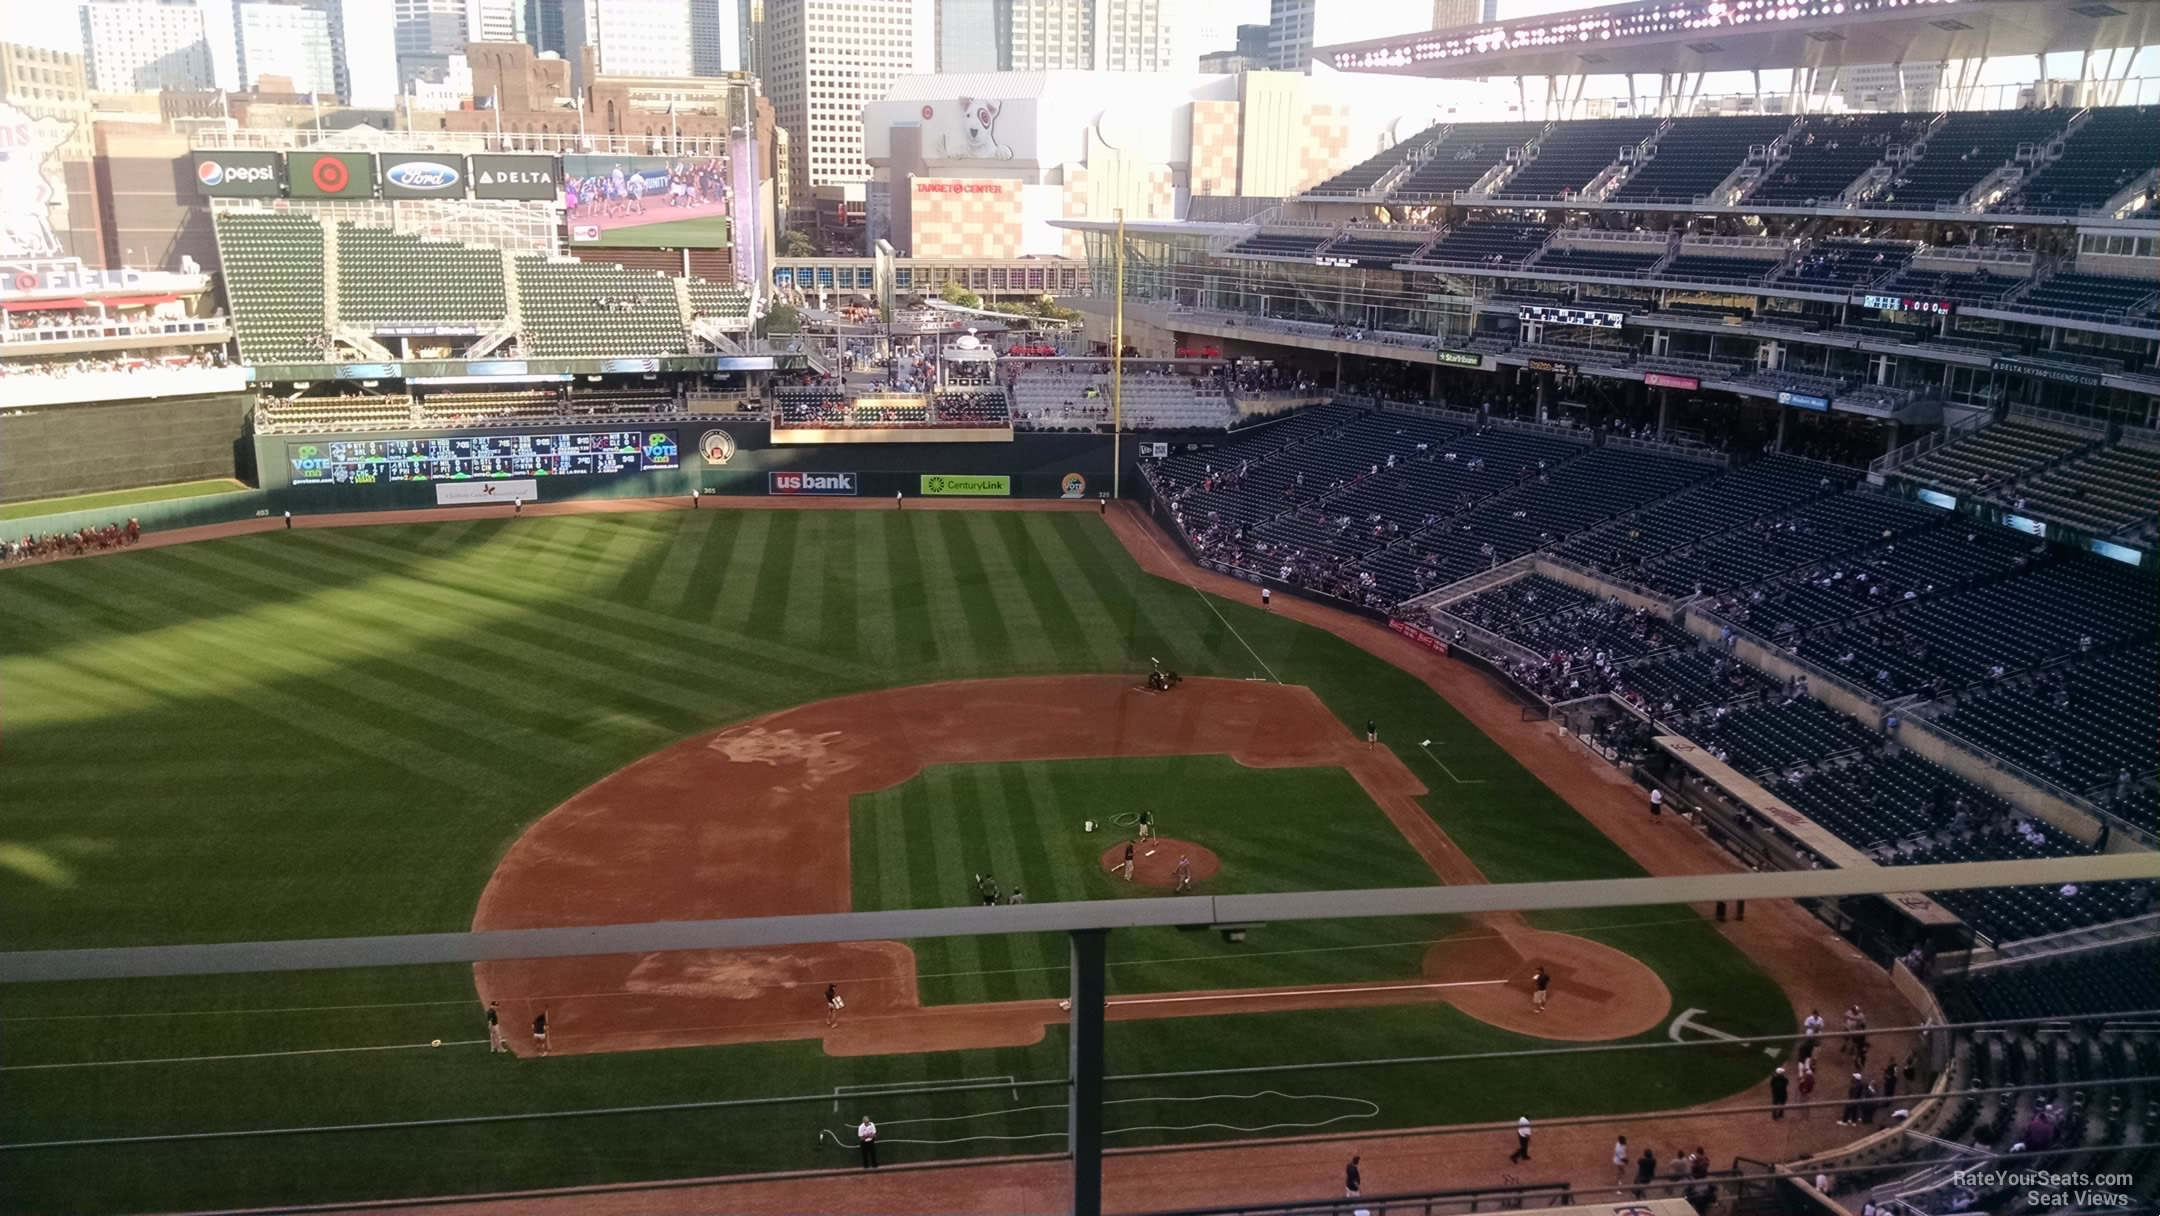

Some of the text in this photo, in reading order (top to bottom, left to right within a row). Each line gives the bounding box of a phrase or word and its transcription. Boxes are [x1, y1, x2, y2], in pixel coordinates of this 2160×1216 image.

[225, 165, 274, 184] pepsi
[399, 167, 445, 186] Ford
[496, 171, 552, 183] DELTA
[916, 183, 1002, 194] TARGET CENTER
[46, 271, 141, 290] FIELD
[2000, 363, 2021, 373] DELTA
[2049, 371, 2078, 383] LEGENDS
[2081, 376, 2098, 386] CLUB
[649, 433, 666, 446] go
[298, 445, 318, 459] go
[642, 445, 677, 456] VOTE
[291, 458, 330, 471] VOTE
[947, 480, 1003, 491] CenturyLink
